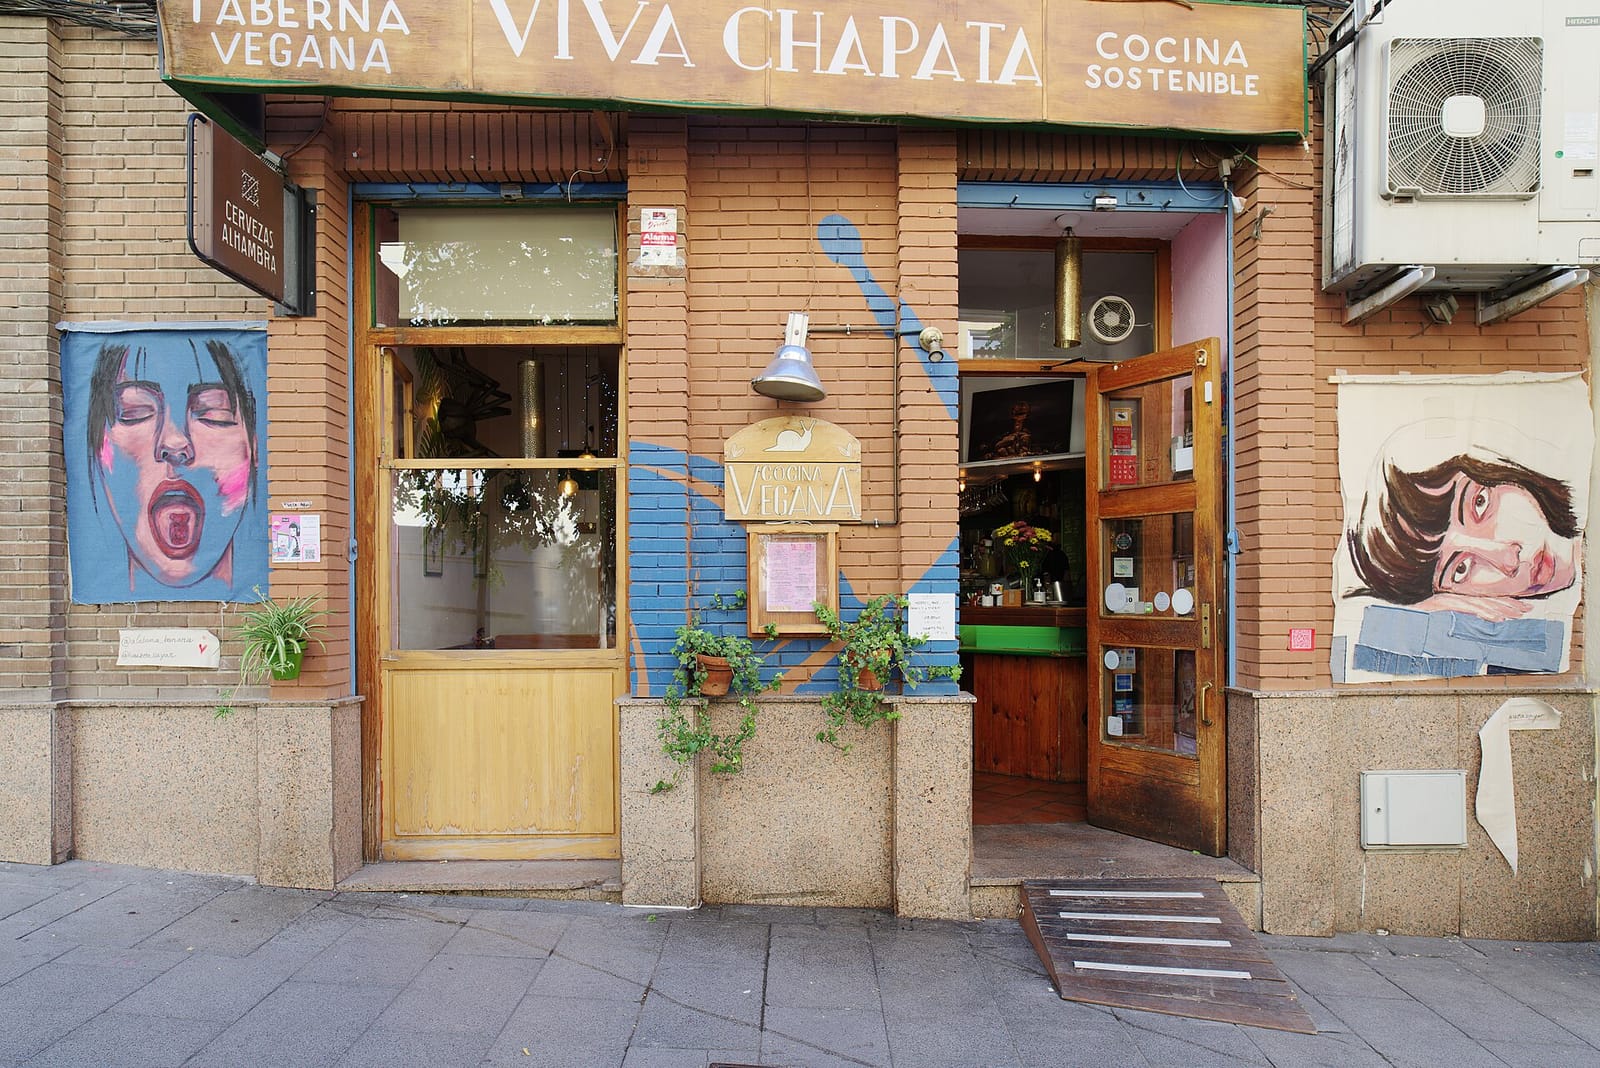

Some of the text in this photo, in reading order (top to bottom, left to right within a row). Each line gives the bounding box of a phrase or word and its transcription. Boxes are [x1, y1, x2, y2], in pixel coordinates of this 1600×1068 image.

[210, 31, 392, 74] VEGANA
[489, 0, 1044, 88] VIVA CHAPATA
[1095, 31, 1249, 68] COCINA
[1084, 64, 1260, 96] SOSTENIBLE
[225, 200, 274, 249] CERVEZAS
[643, 233, 675, 241] Alarma
[222, 224, 277, 275] ALHAMBRA
[727, 464, 858, 518] VEGANA
[760, 464, 823, 482] COCINA
